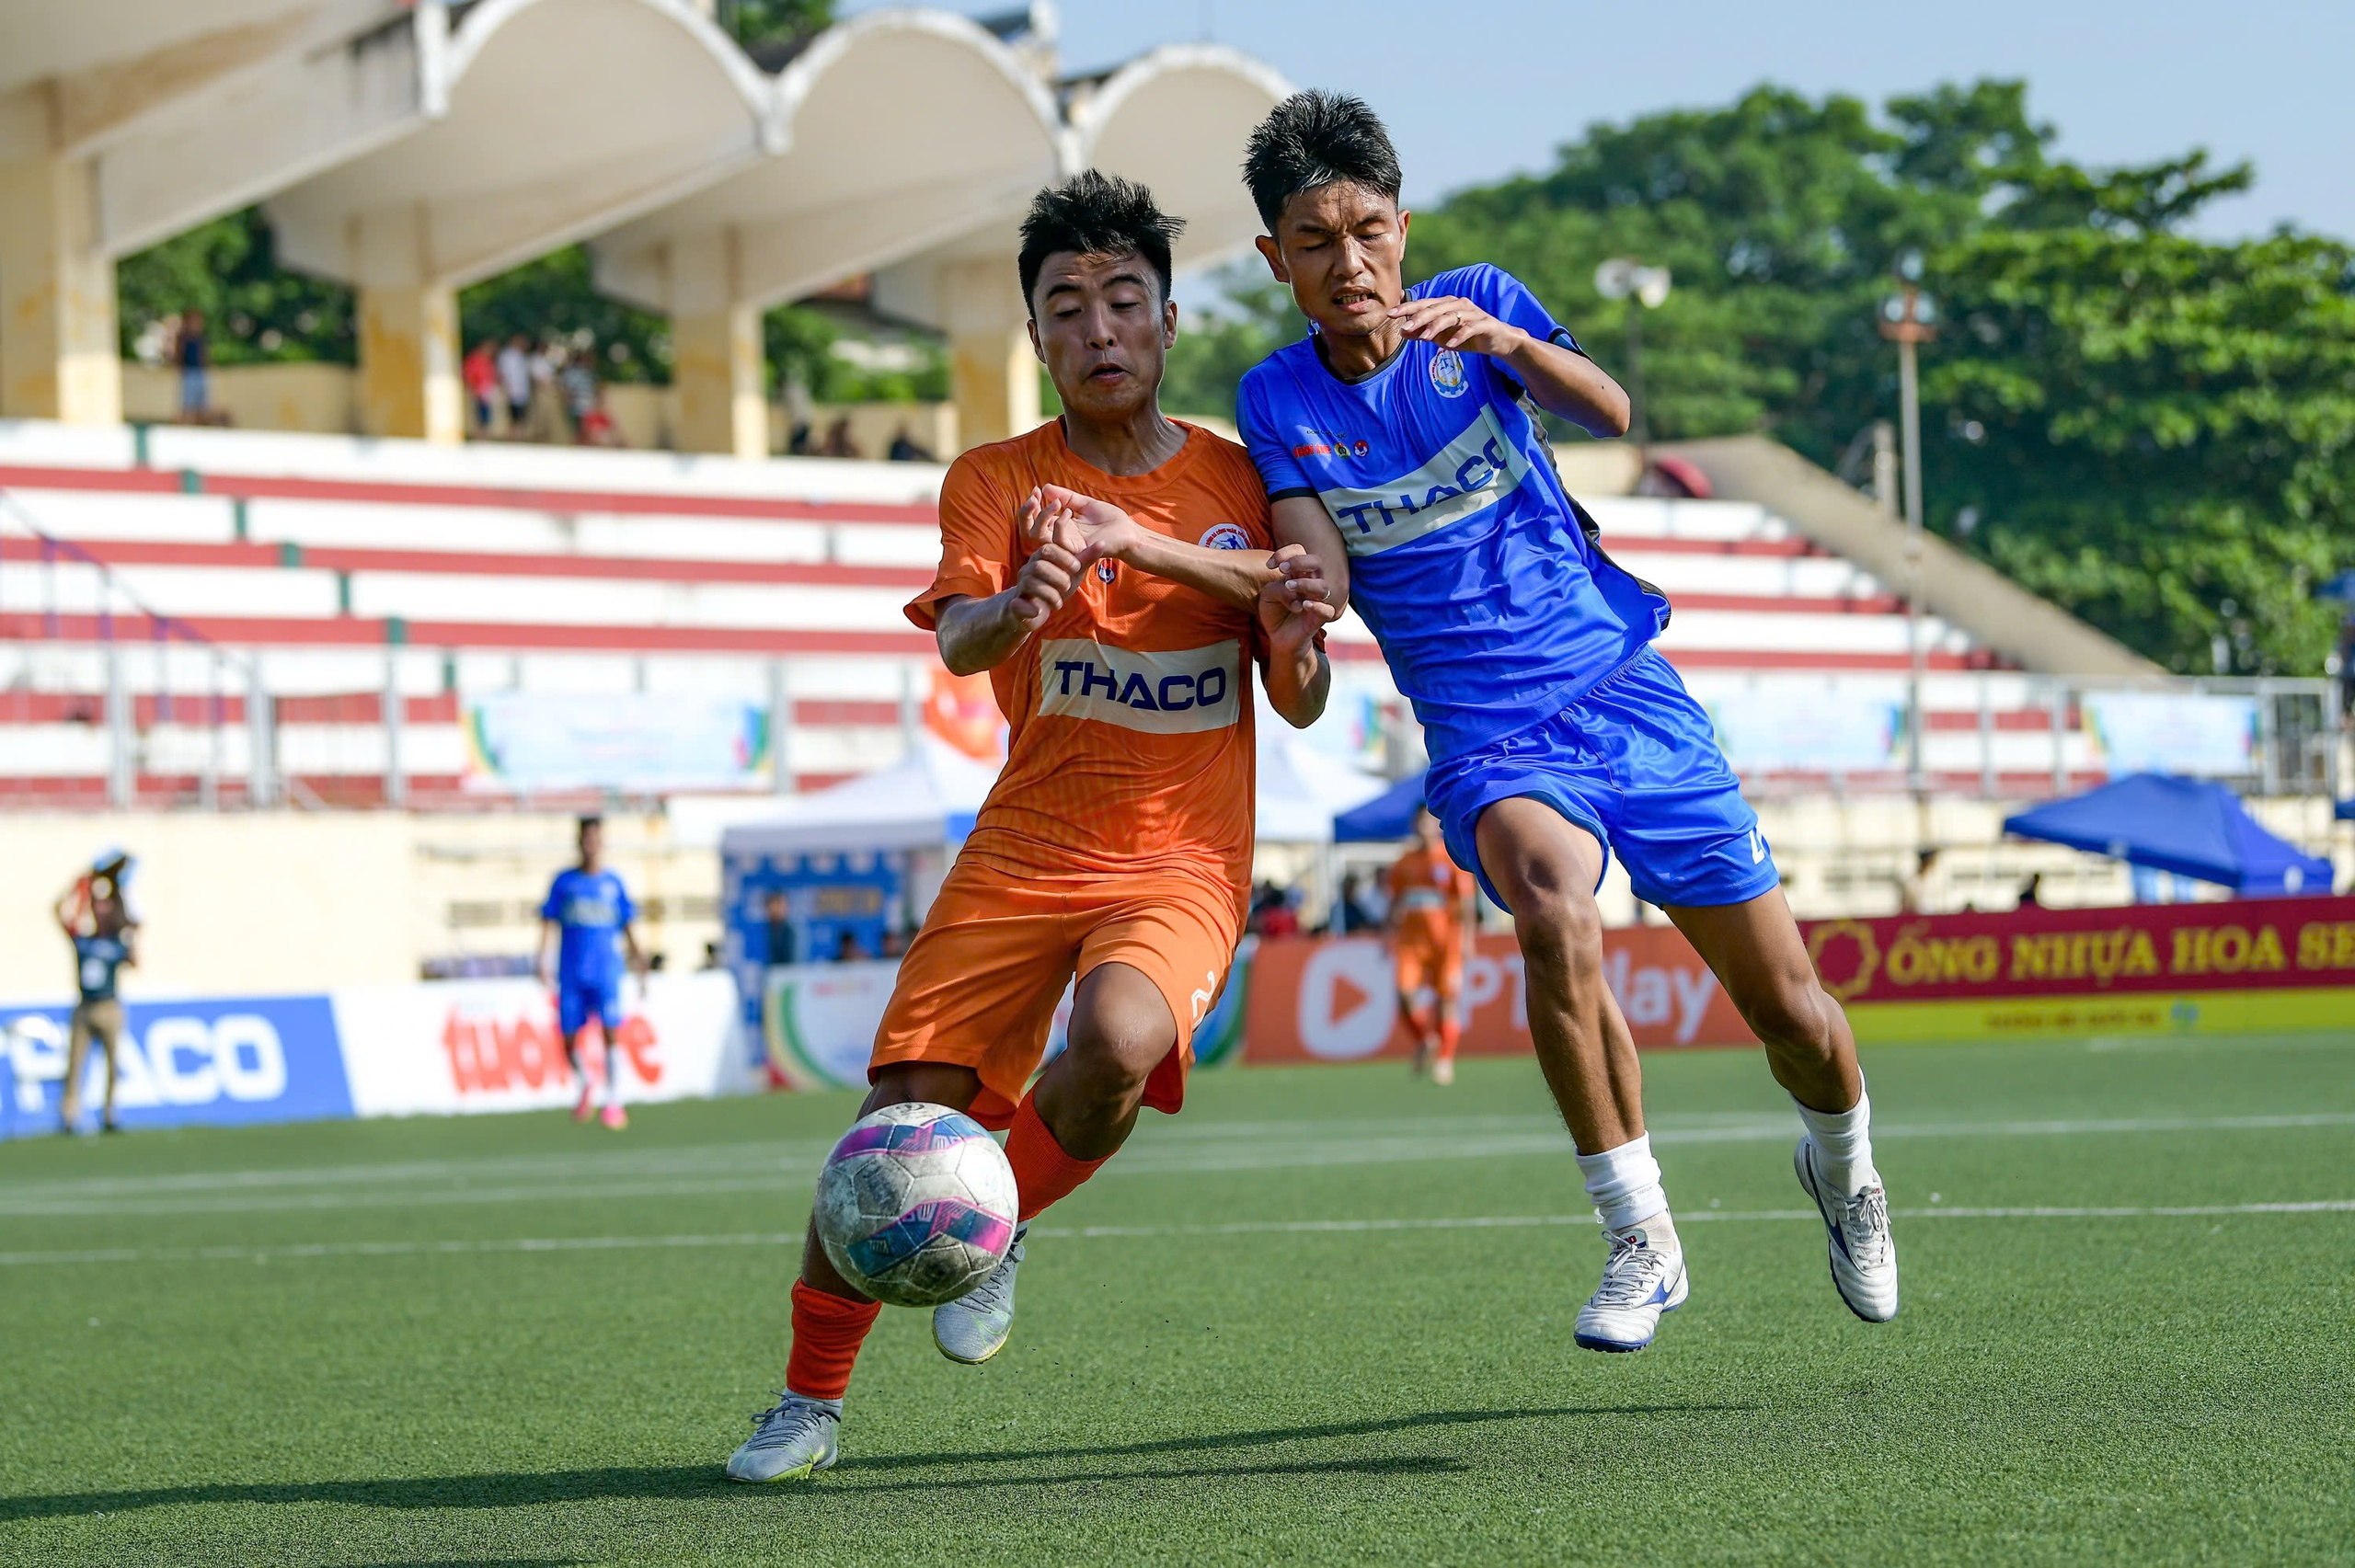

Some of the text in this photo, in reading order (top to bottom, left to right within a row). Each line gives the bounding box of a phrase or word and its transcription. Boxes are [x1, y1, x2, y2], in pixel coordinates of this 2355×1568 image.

[1336, 436, 1508, 534] THACO
[1054, 660, 1226, 712] THACO
[2170, 922, 2287, 975] HOA
[1457, 948, 1718, 1045] PT lay
